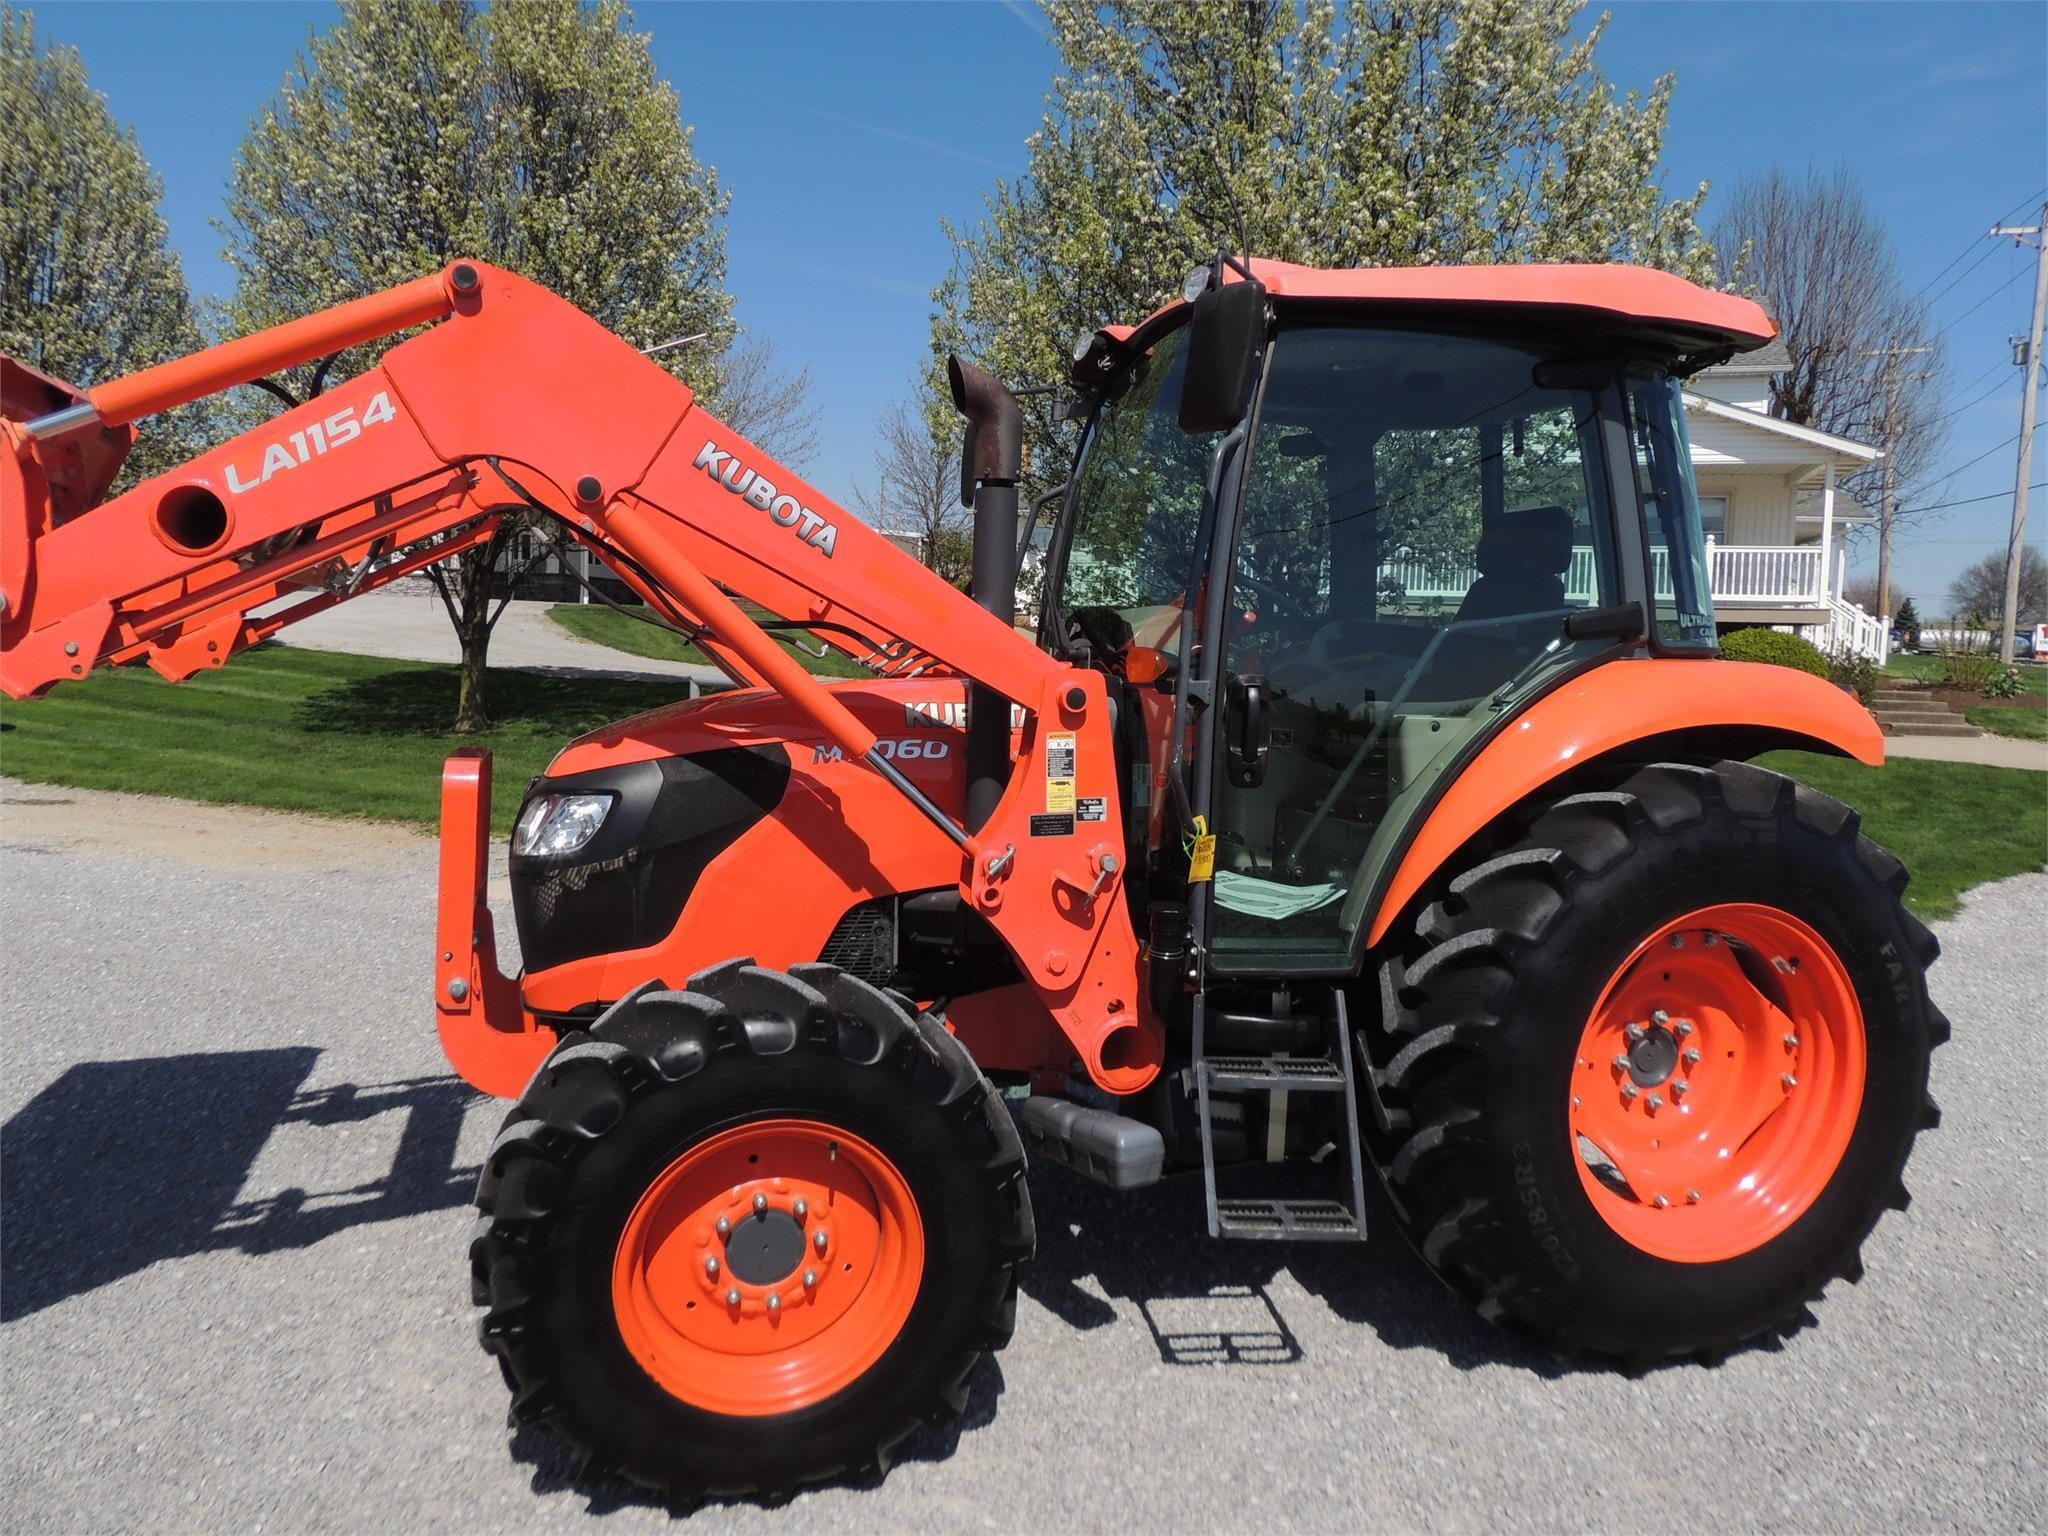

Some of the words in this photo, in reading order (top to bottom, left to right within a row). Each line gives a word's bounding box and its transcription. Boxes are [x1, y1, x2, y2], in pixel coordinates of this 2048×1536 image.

[224, 391, 396, 494] LA1154
[692, 439, 838, 559] KUBOTA
[813, 738, 949, 765] M060
